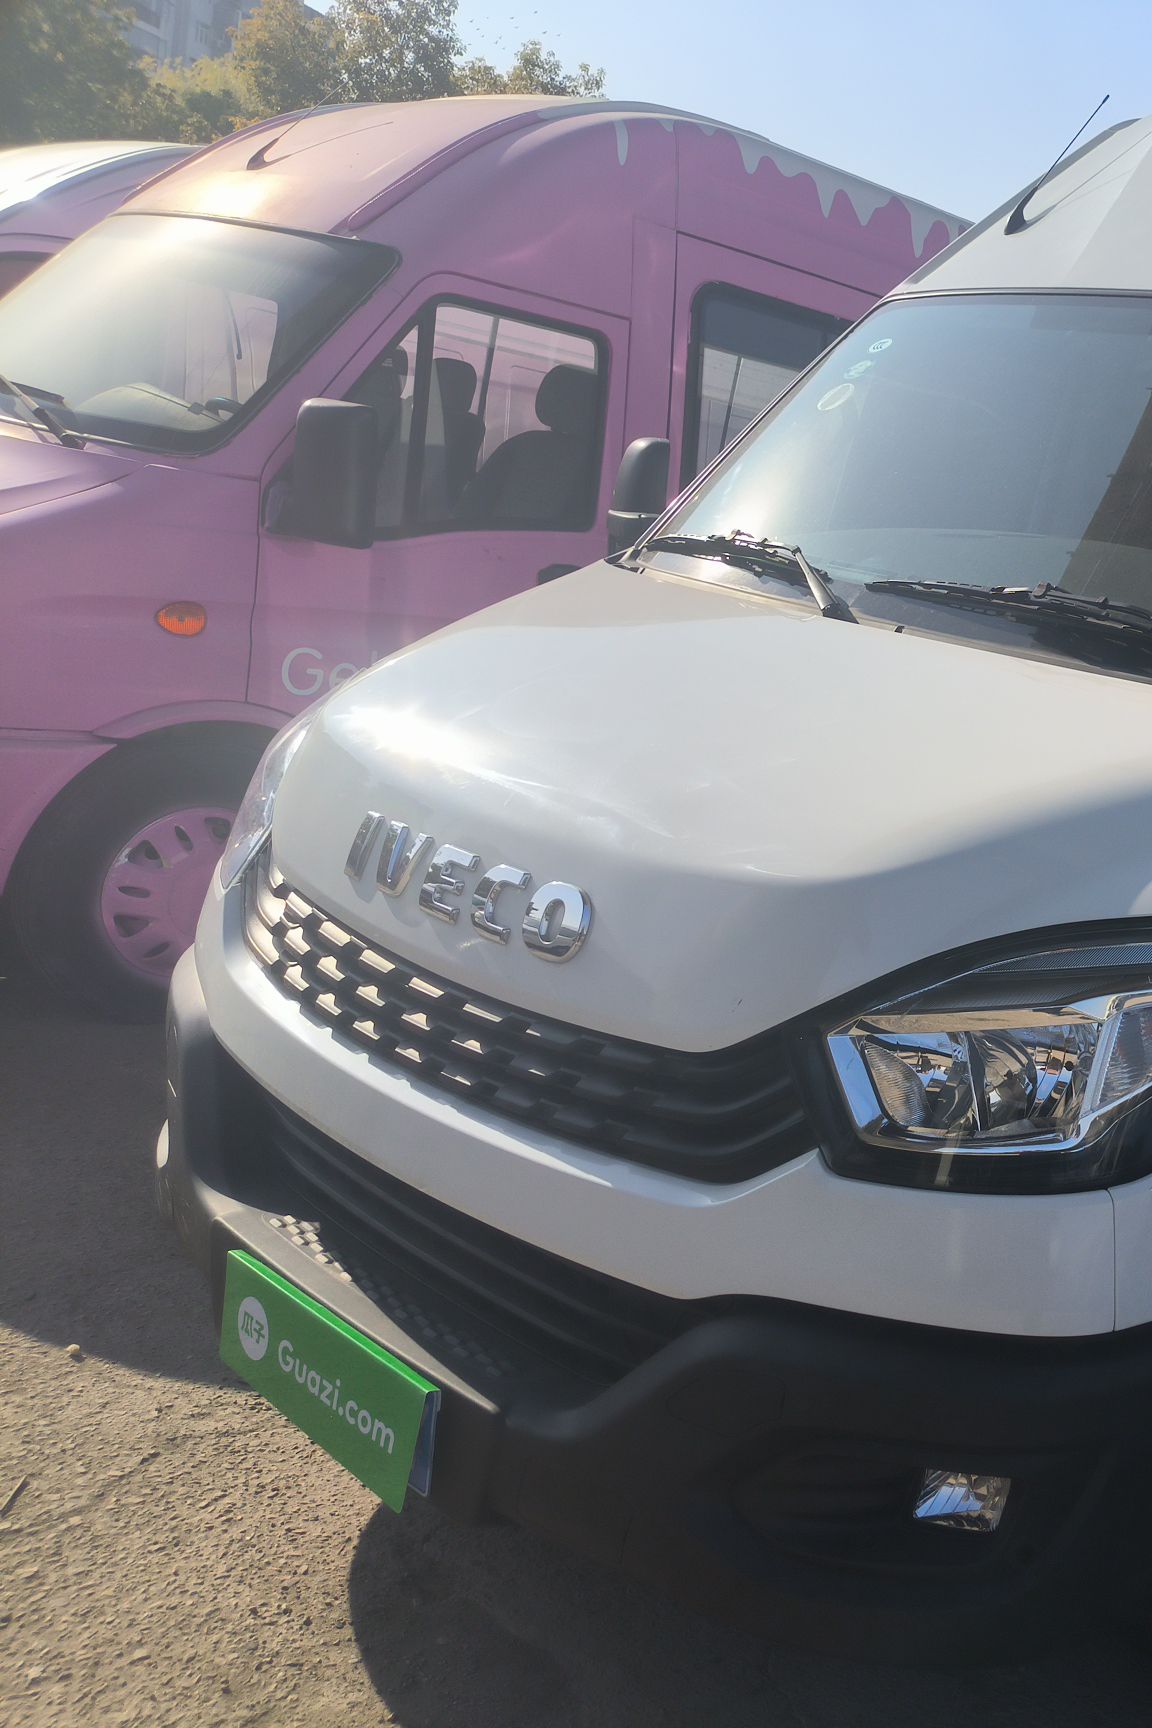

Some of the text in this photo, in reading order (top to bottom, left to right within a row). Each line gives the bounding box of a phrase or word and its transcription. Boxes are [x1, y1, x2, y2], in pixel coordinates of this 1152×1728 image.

[281, 646, 379, 696] Ge
[343, 810, 593, 964] IVECO
[241, 1310, 266, 1344] 瓜子
[277, 1339, 395, 1455] Guazi.com
